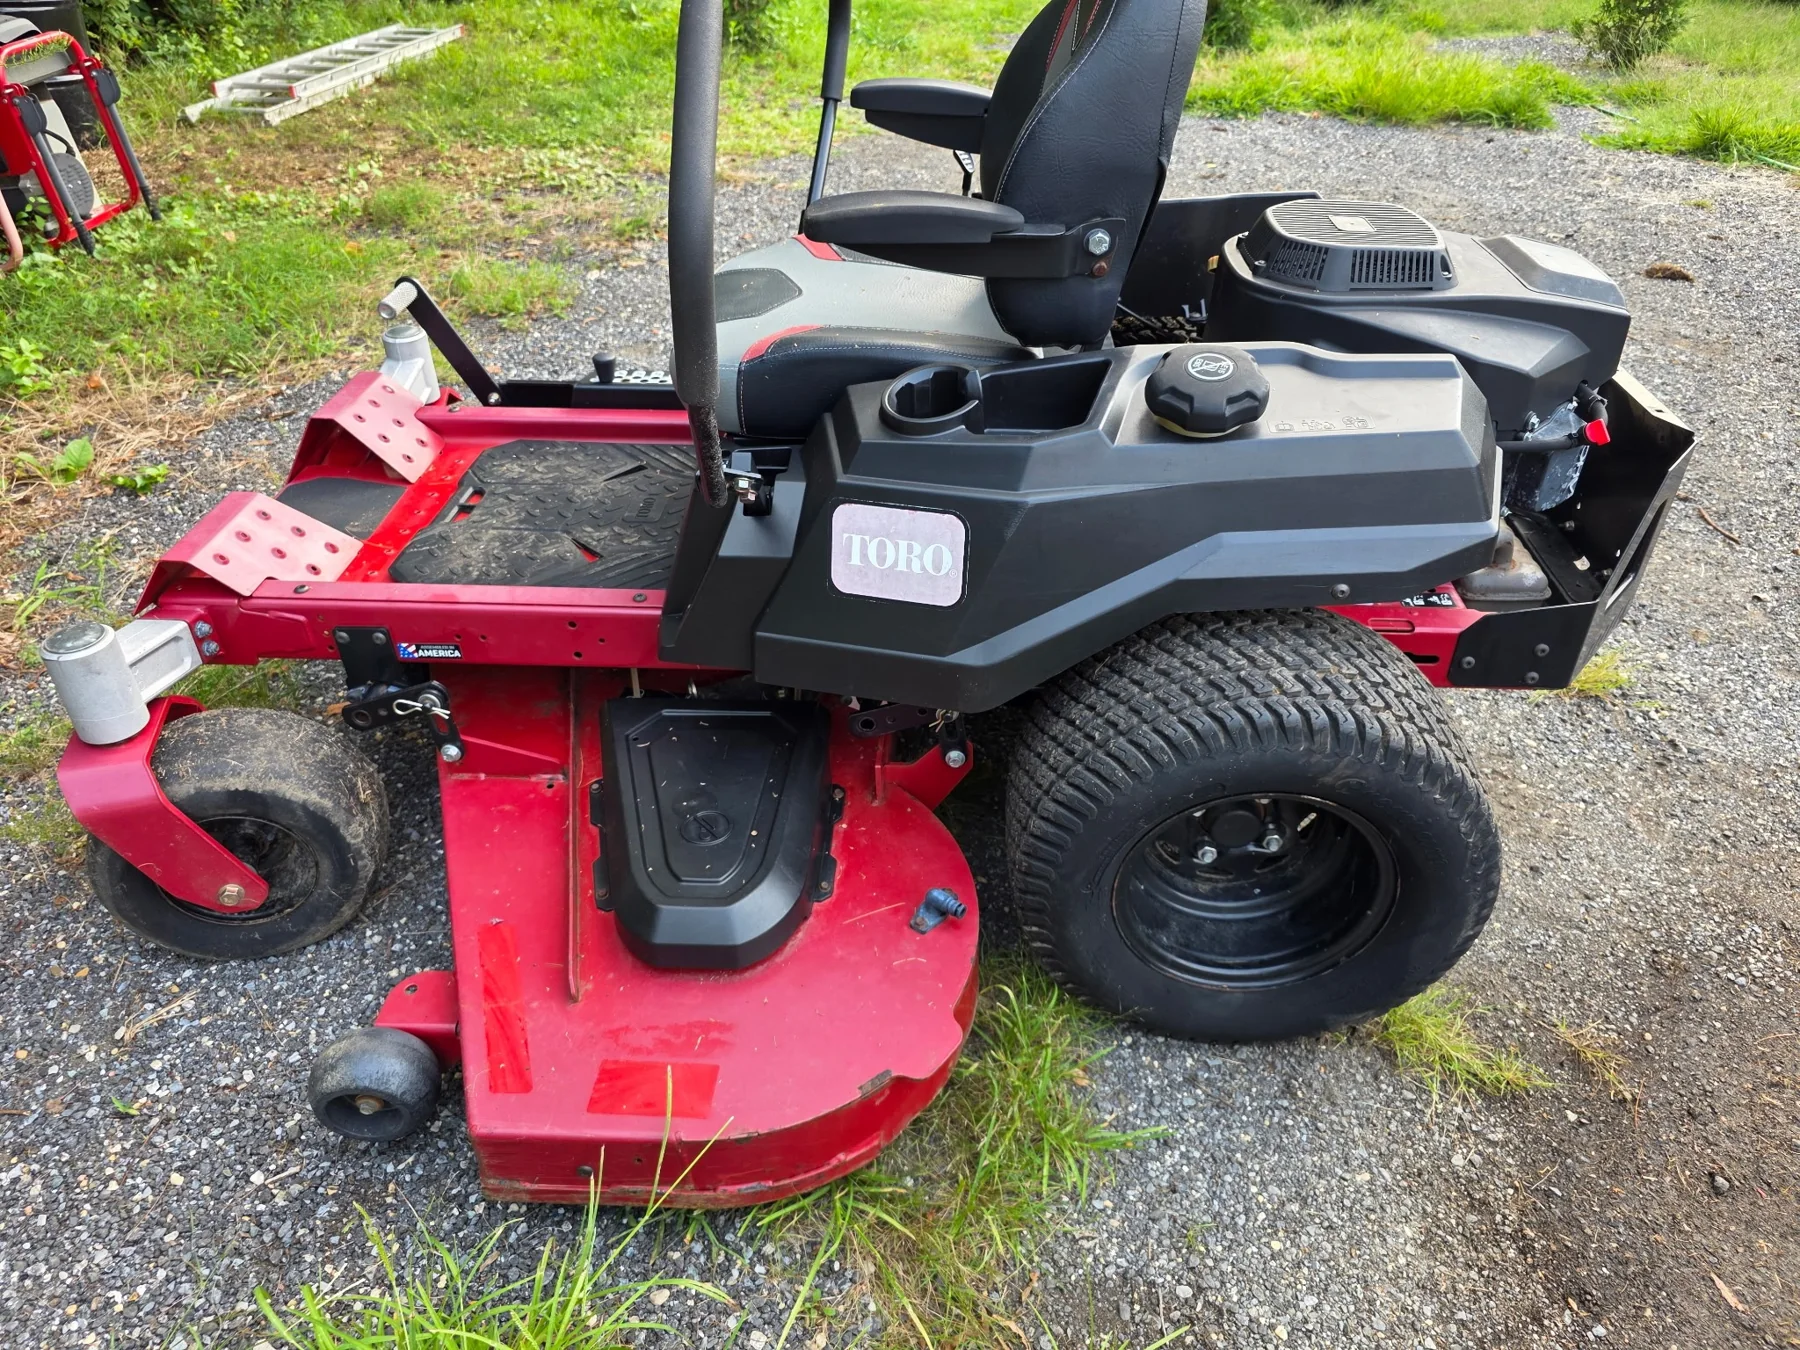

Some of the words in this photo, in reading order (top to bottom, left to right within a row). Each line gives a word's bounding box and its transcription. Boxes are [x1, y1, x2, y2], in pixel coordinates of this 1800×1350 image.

[635, 497, 656, 518] TORO
[842, 533, 953, 577] TORO
[418, 649, 461, 658] AMERICA
